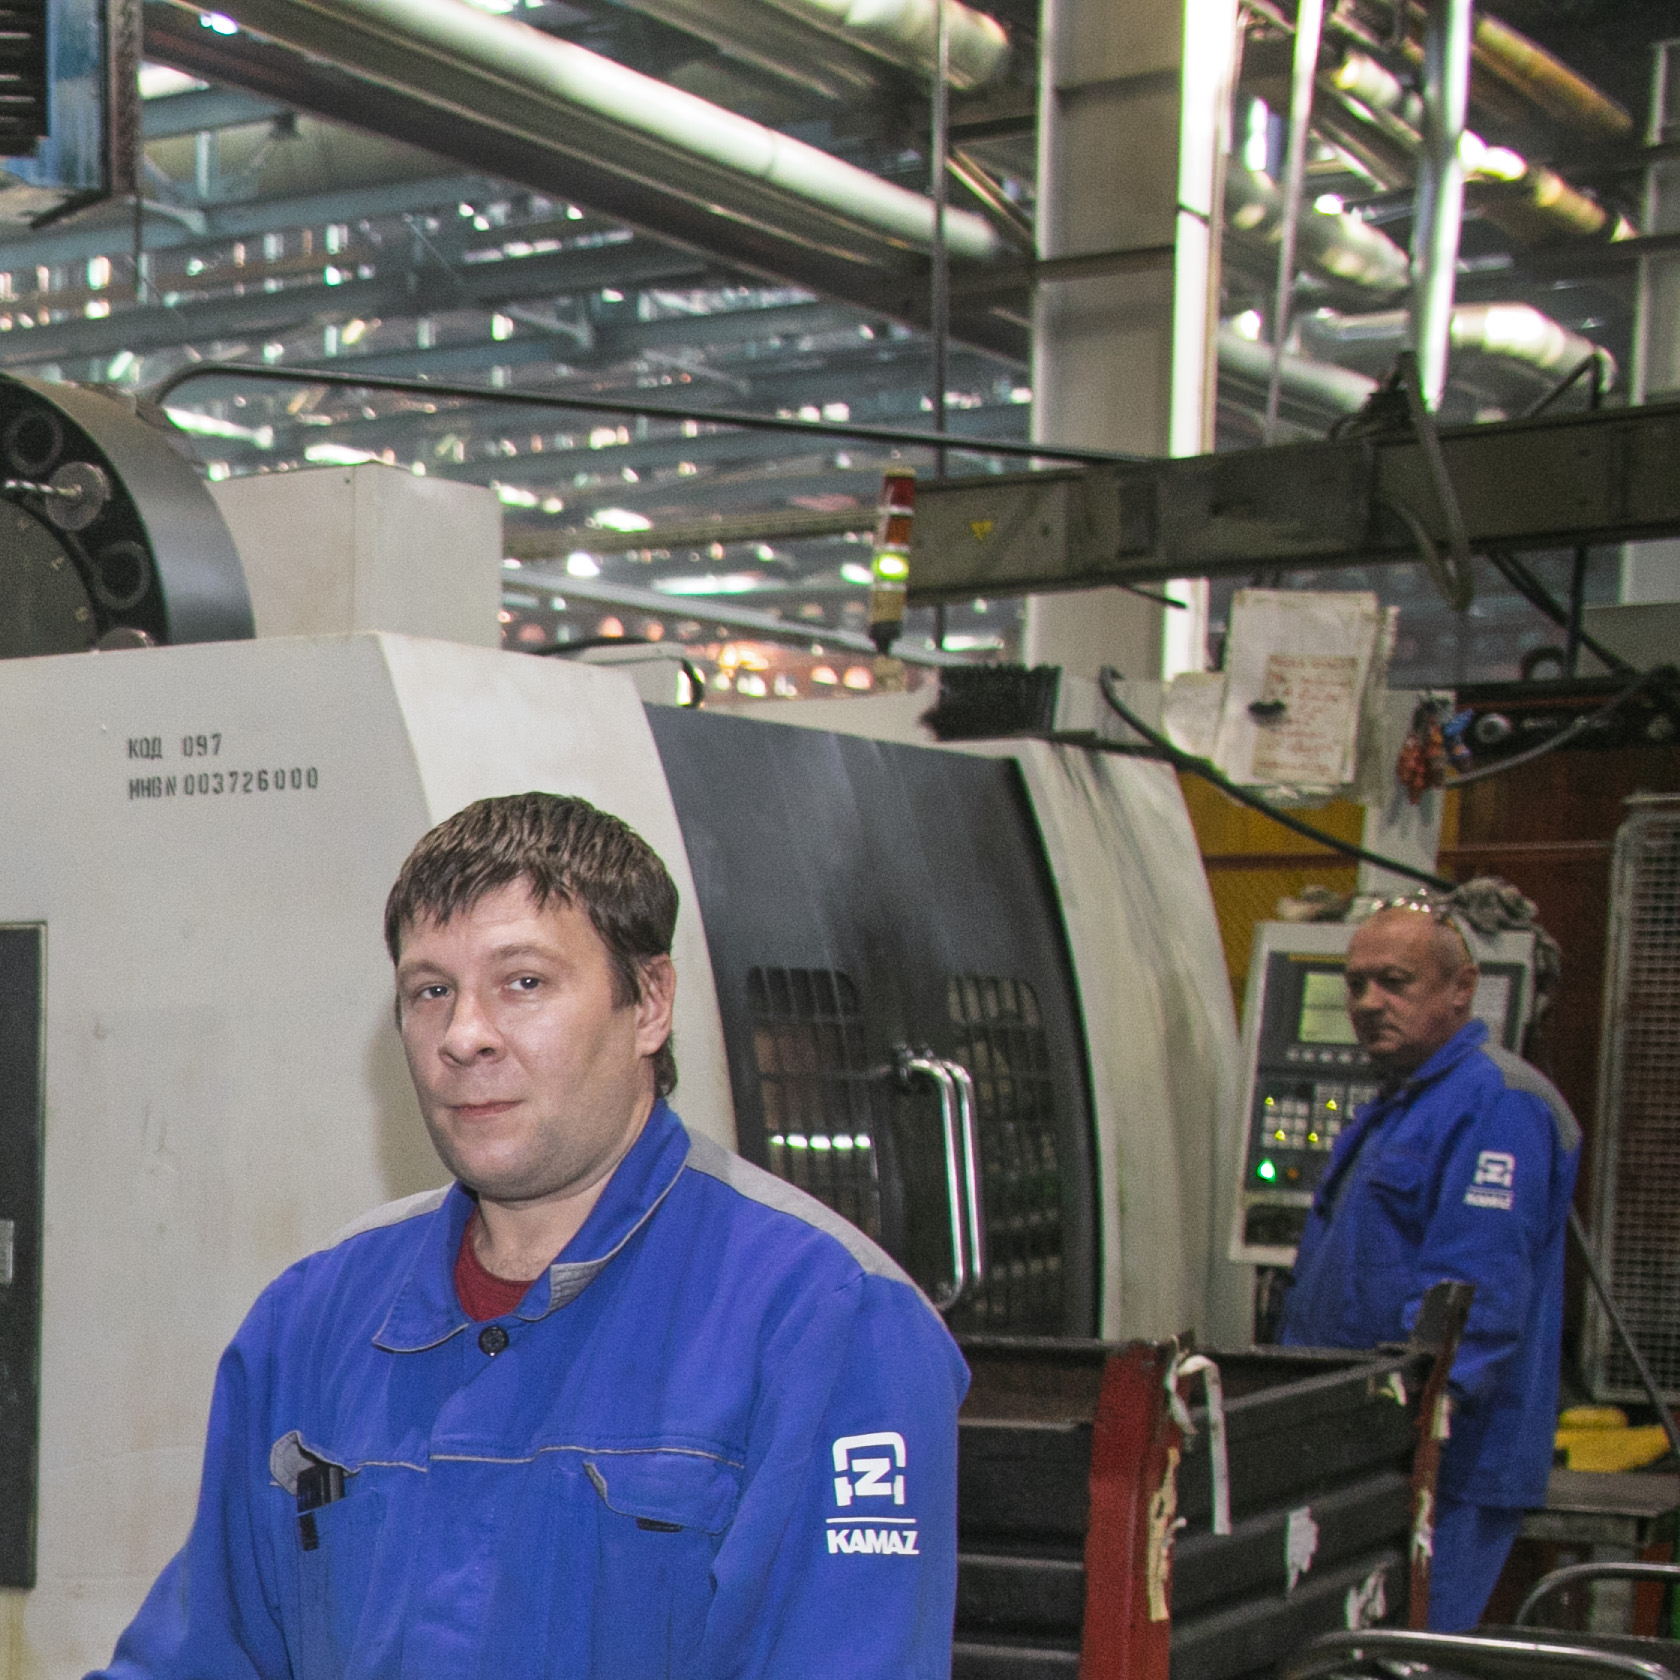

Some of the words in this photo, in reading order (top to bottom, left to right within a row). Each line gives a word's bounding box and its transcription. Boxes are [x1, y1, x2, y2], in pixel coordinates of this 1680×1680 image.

[127, 736, 163, 760] КОД
[182, 732, 222, 758] 097
[183, 766, 319, 797] 003726000
[825, 1529, 921, 1555] KAMAZ
